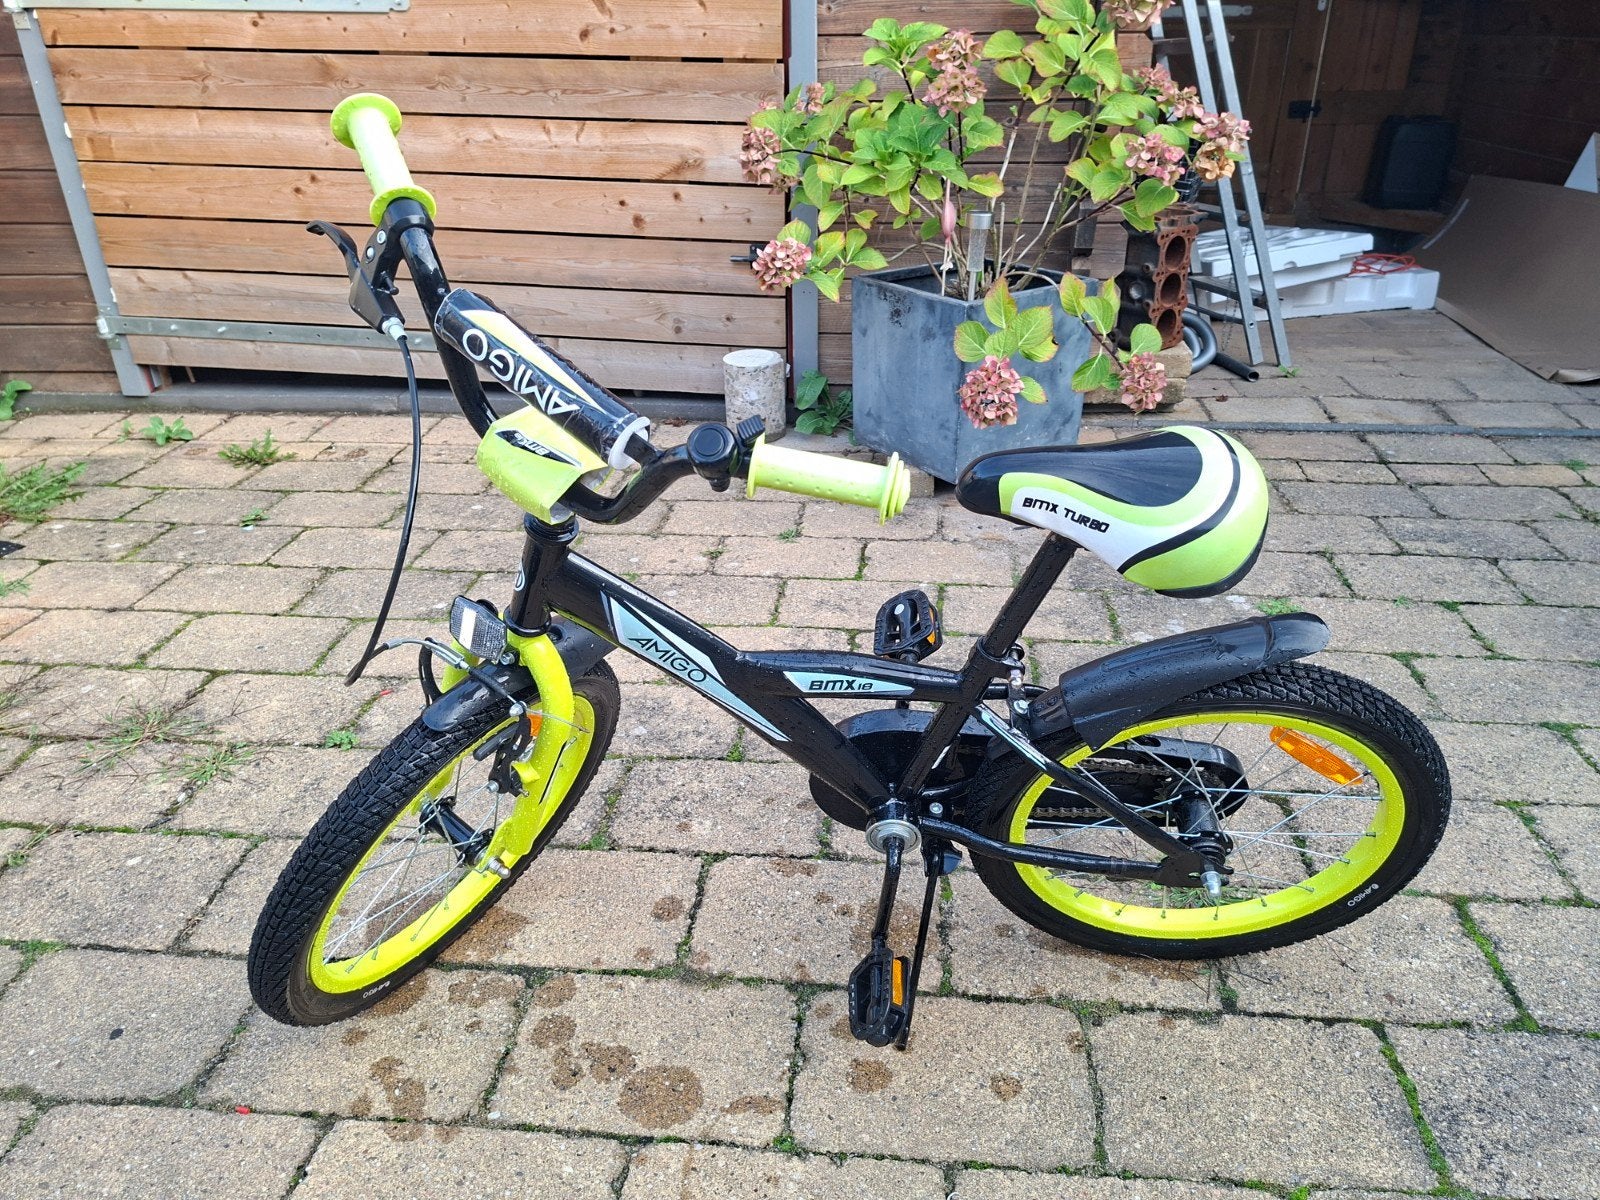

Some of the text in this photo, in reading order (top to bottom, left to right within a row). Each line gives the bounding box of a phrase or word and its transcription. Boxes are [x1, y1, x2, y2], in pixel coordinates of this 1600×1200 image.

[462, 328, 581, 415] AMIGO
[1022, 497, 1110, 533] BMX TURBO
[627, 637, 708, 683] AMIGO
